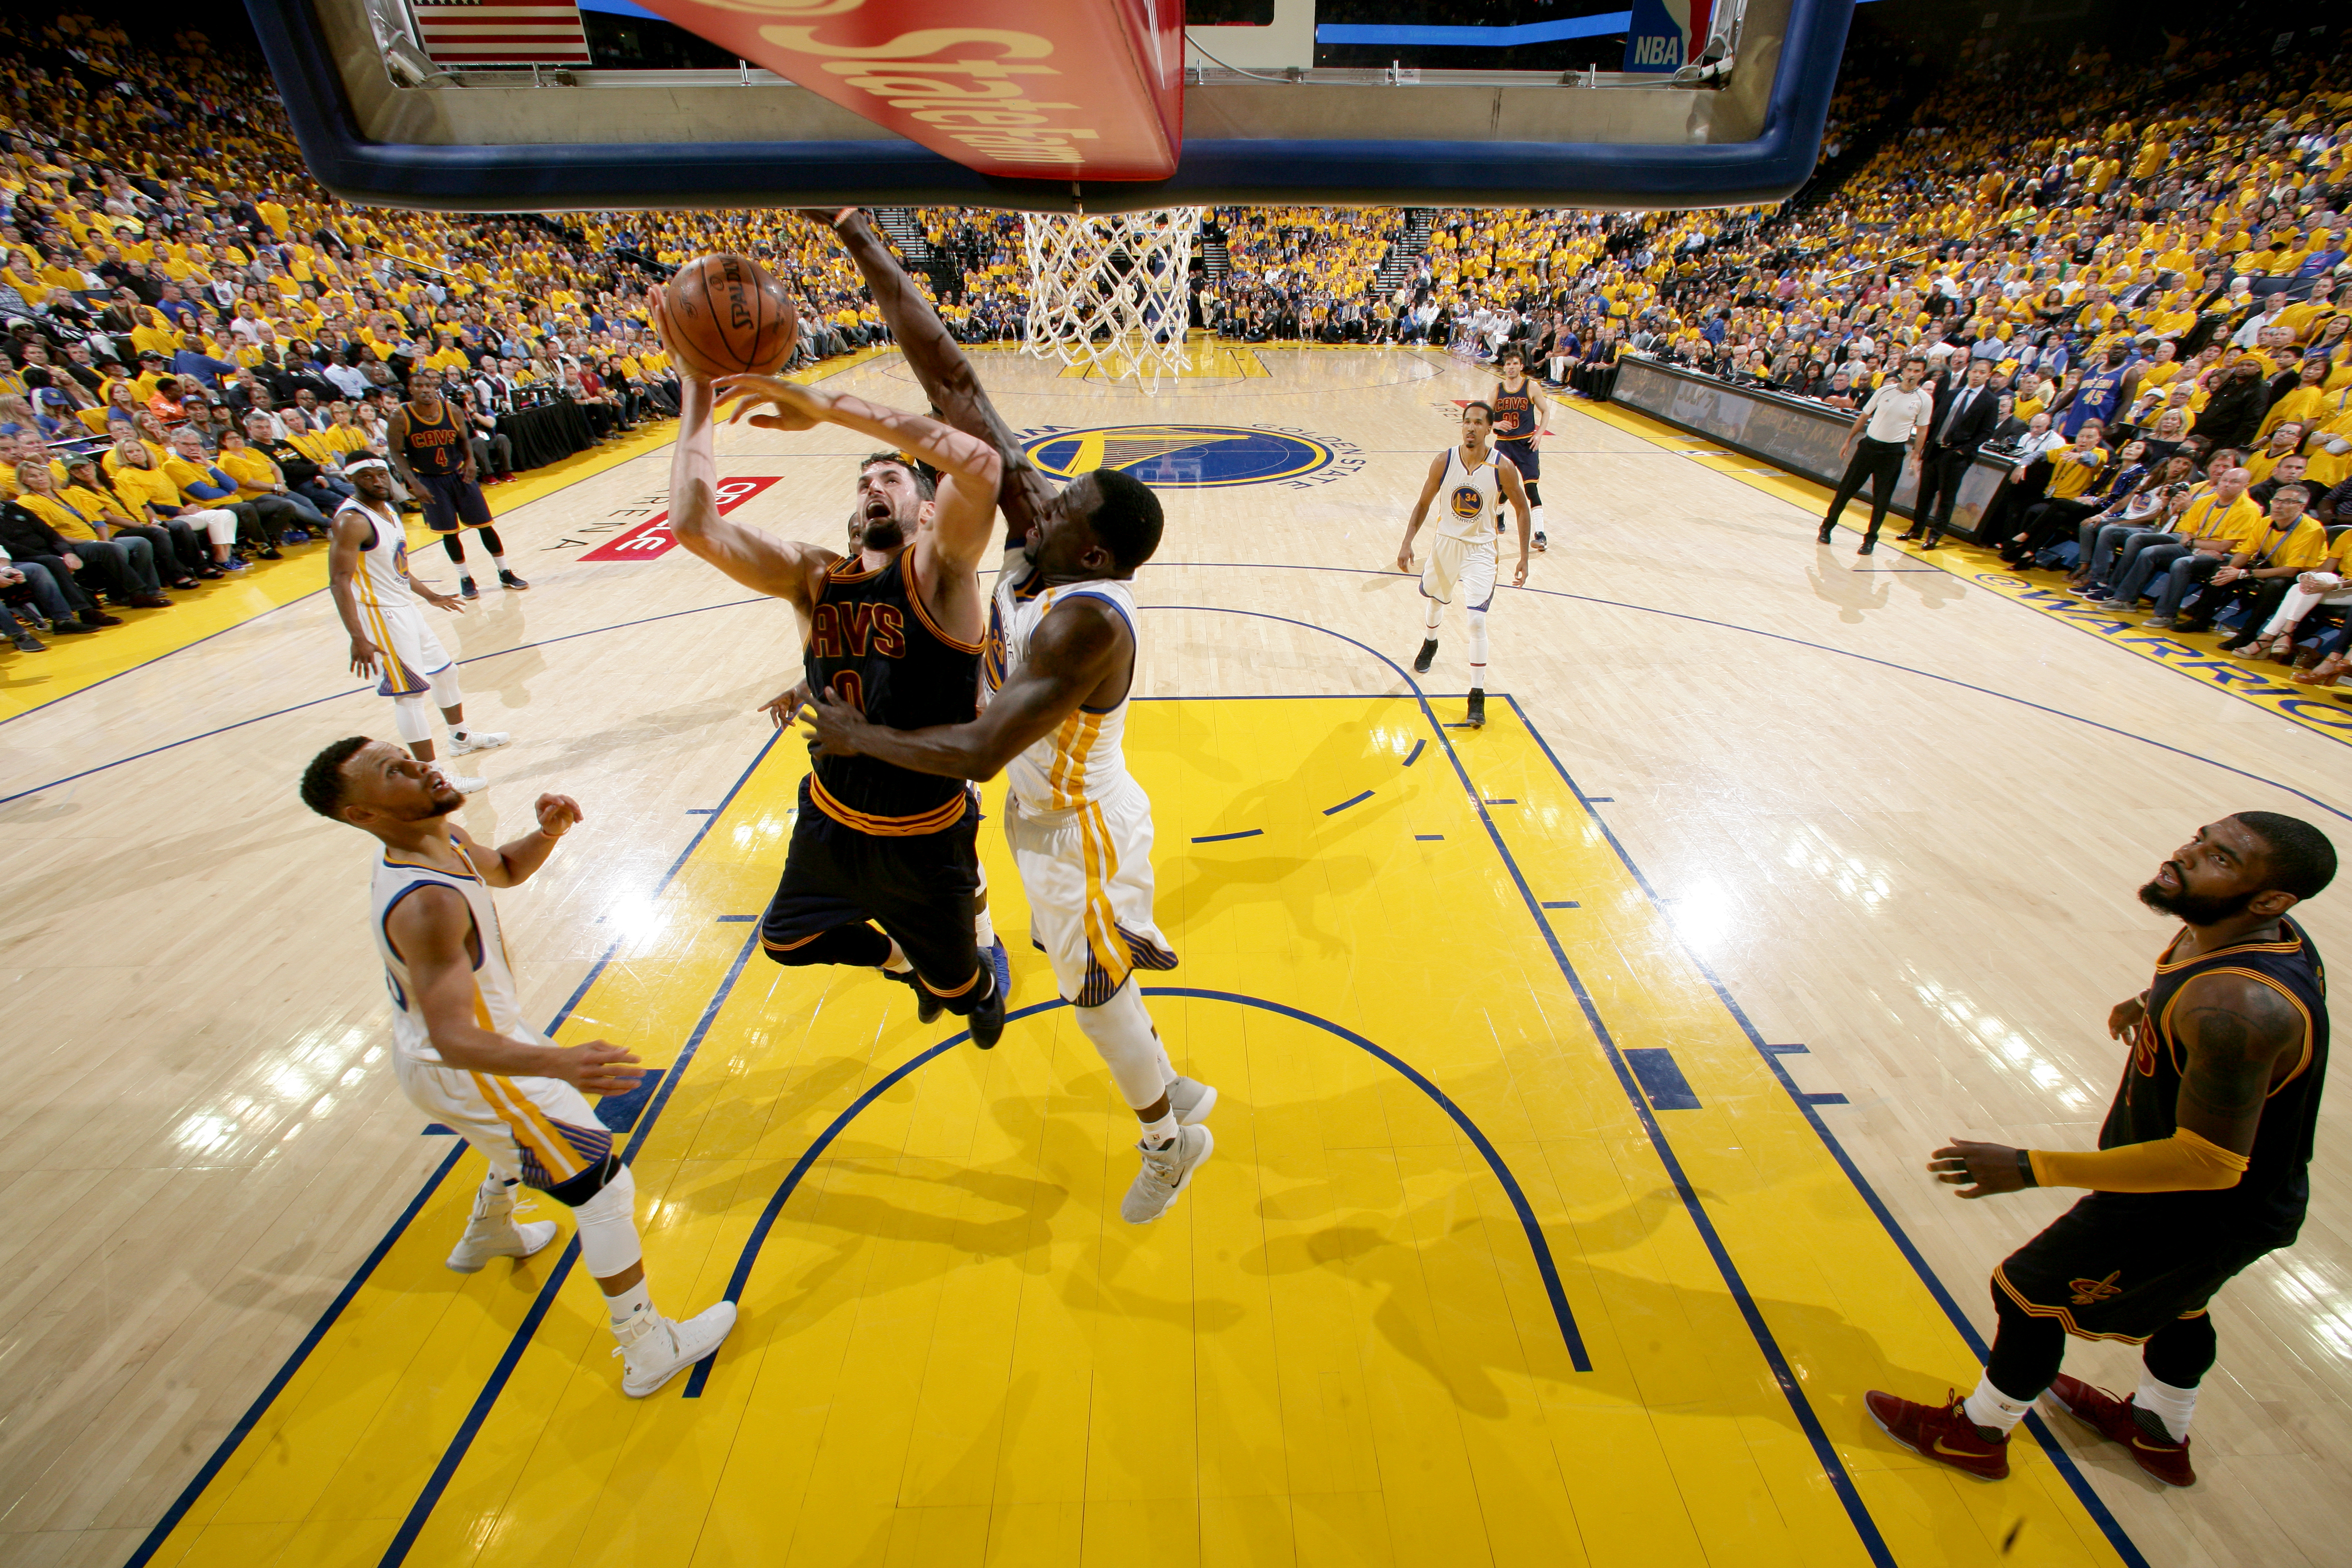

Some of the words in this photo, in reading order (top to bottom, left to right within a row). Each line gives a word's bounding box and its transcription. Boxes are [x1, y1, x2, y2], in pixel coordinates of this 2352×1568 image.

[1634, 36, 1678, 65] NBA
[759, 25, 1082, 124] State
[931, 124, 1100, 163] Farm
[1495, 397, 1528, 412] CAVS
[1677, 385, 1707, 406] JULY
[1704, 393, 1717, 408] 7
[2082, 389, 2107, 406] 45
[411, 429, 457, 448] CAVS
[1252, 423, 1365, 455] GOLDEN
[435, 447, 447, 467] 4
[1276, 459, 1366, 490] STATE
[1451, 482, 1470, 492] GOLDEN
[1471, 484, 1484, 494] STATE
[1465, 493, 1477, 503] 34
[539, 489, 670, 551] RENA
[1451, 510, 1483, 523] WARRIORS
[812, 601, 906, 659] AVS
[1974, 573, 2352, 739] @WARRIO
